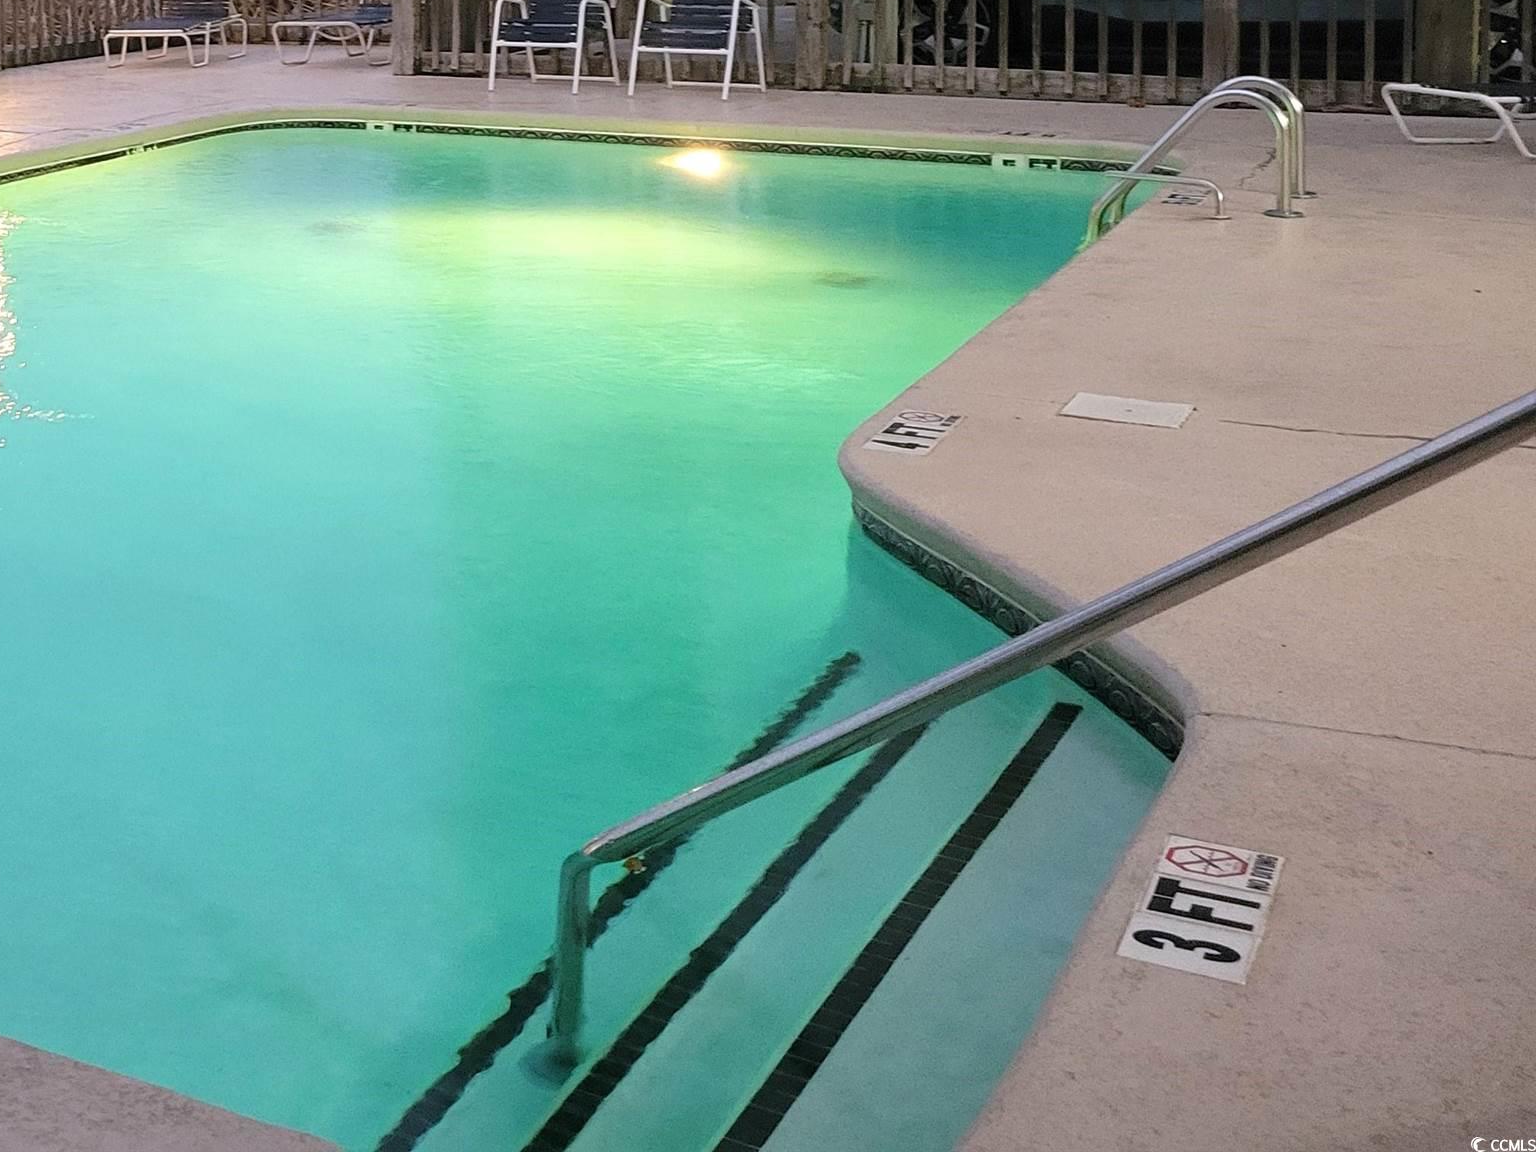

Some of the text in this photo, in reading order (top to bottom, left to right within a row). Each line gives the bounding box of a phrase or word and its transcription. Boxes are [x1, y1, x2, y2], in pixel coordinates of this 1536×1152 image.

[881, 422, 946, 440] FT
[1132, 876, 1261, 963] 3 FT
